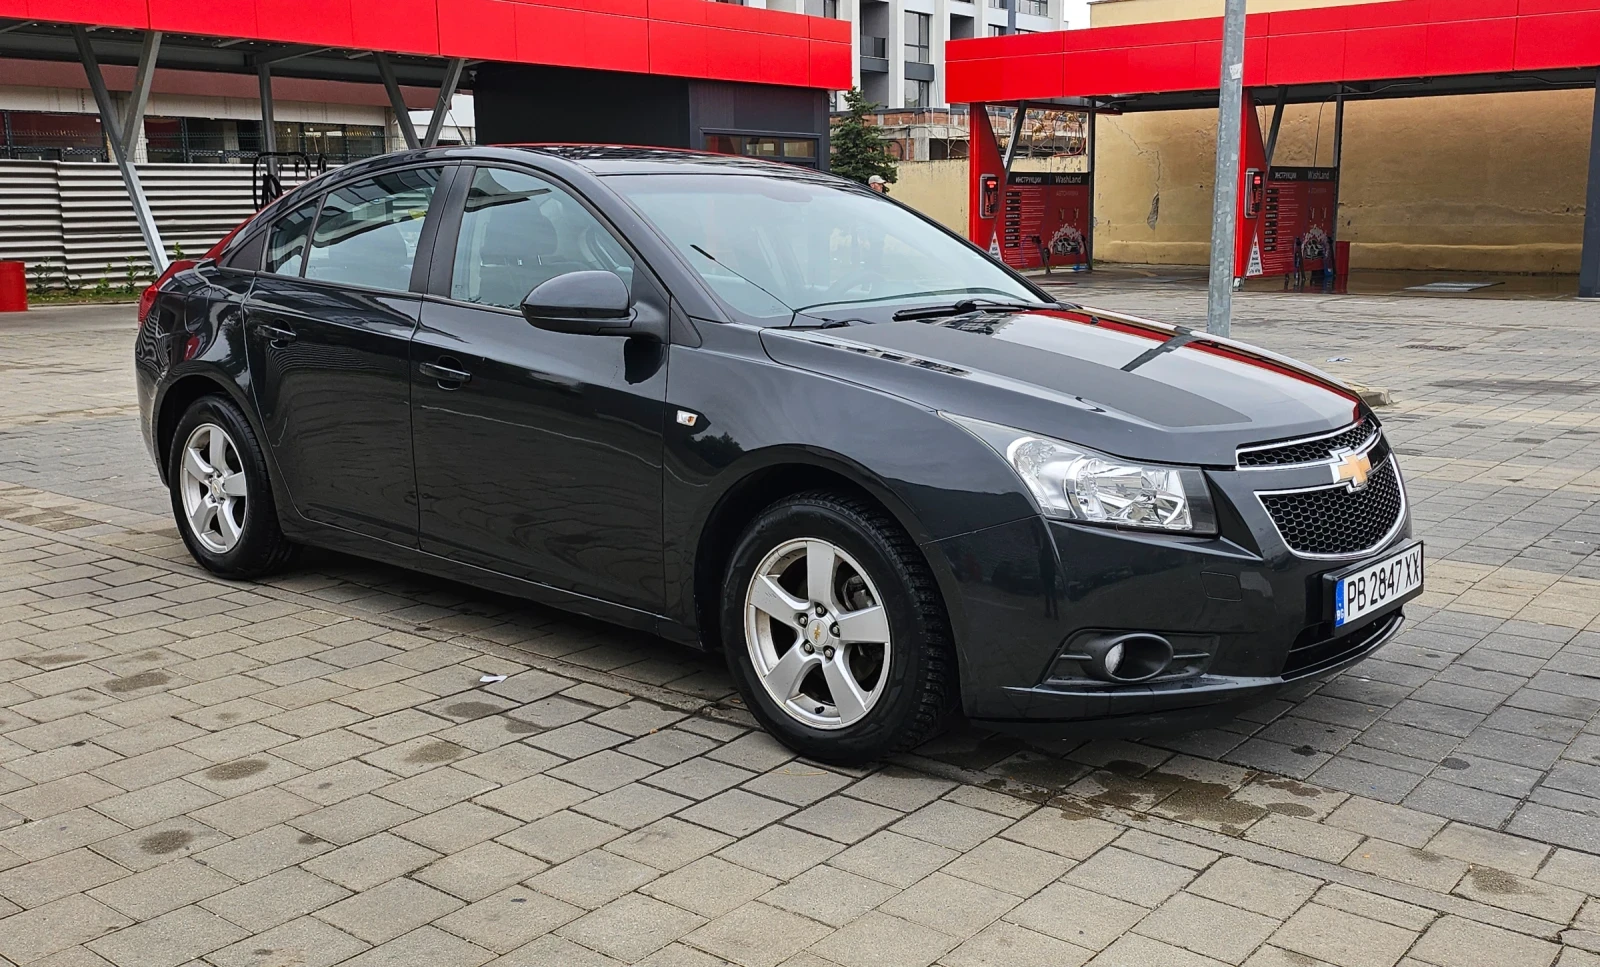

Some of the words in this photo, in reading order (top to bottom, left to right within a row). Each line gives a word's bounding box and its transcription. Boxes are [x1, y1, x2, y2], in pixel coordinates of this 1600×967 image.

[1055, 176, 1082, 184] WashLand
[1347, 576, 1367, 617] PB
[1369, 558, 1403, 606] 2847
[1405, 550, 1419, 589] XX
